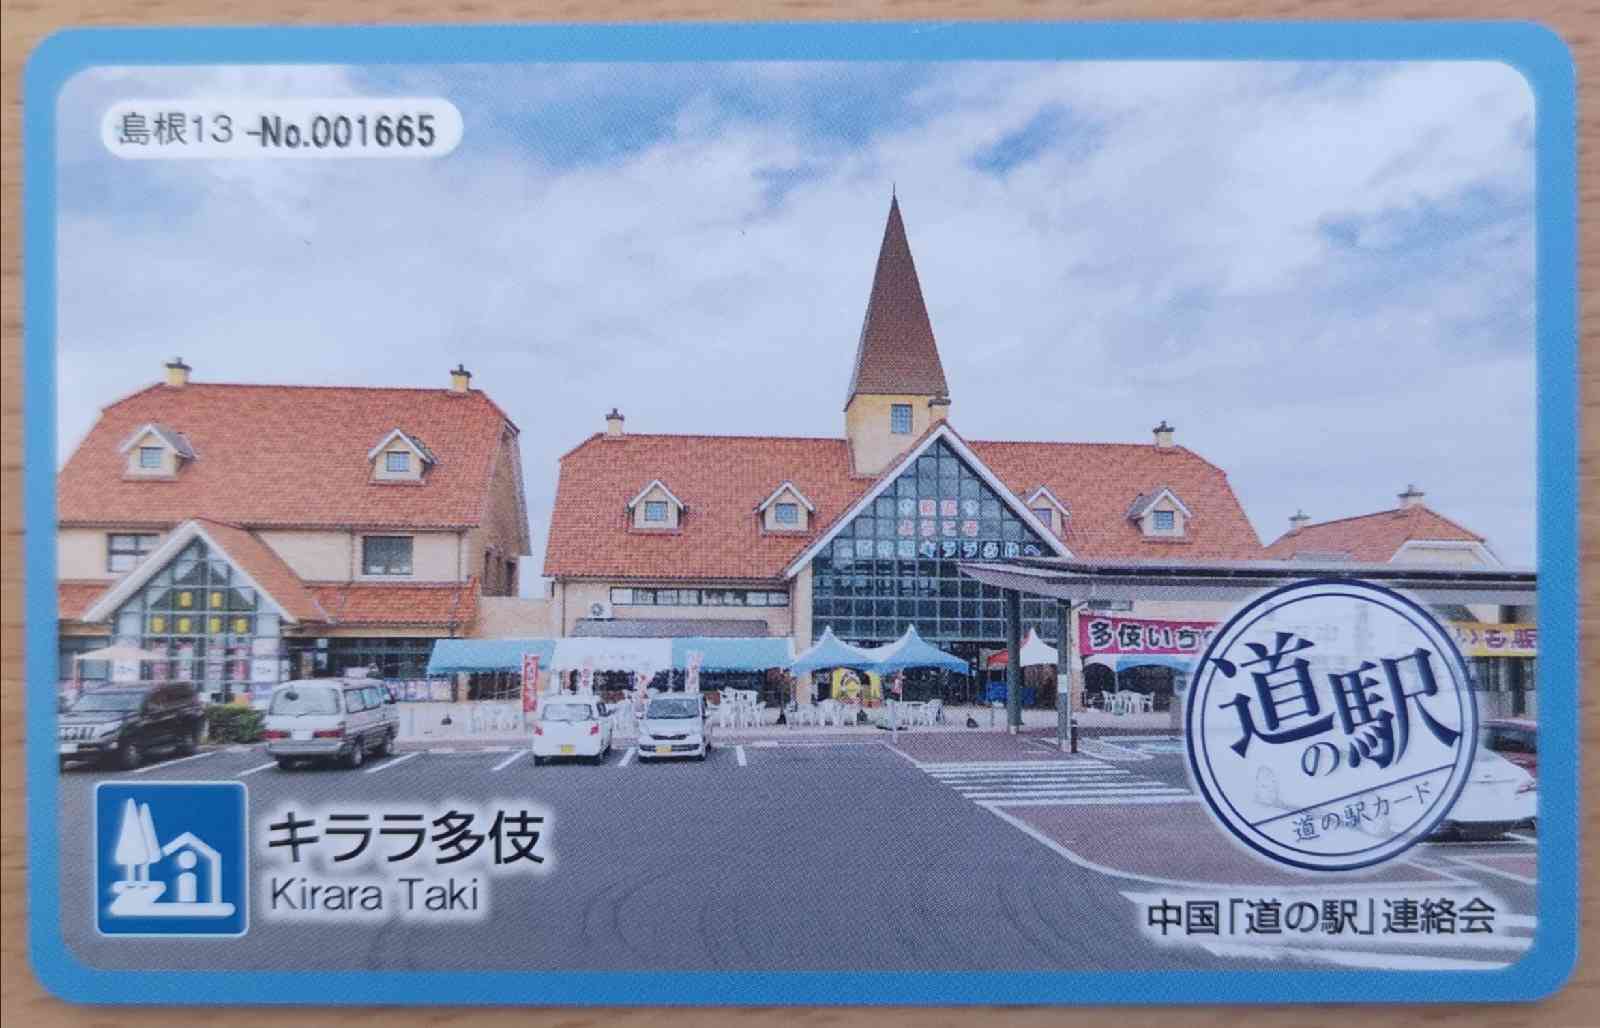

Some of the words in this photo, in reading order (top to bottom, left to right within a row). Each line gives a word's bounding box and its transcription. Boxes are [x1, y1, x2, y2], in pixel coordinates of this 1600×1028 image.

[118, 112, 233, 146] 島根13
[1090, 620, 1213, 649] 多伎いち
[1209, 631, 1462, 777] 道の駅
[1291, 781, 1432, 842] 道の駅カード
[268, 809, 545, 865] キララ多伎
[270, 878, 384, 911] Kirara
[398, 878, 479, 911] Taki
[1147, 897, 1496, 936] 中国「道の駅」連絡会
